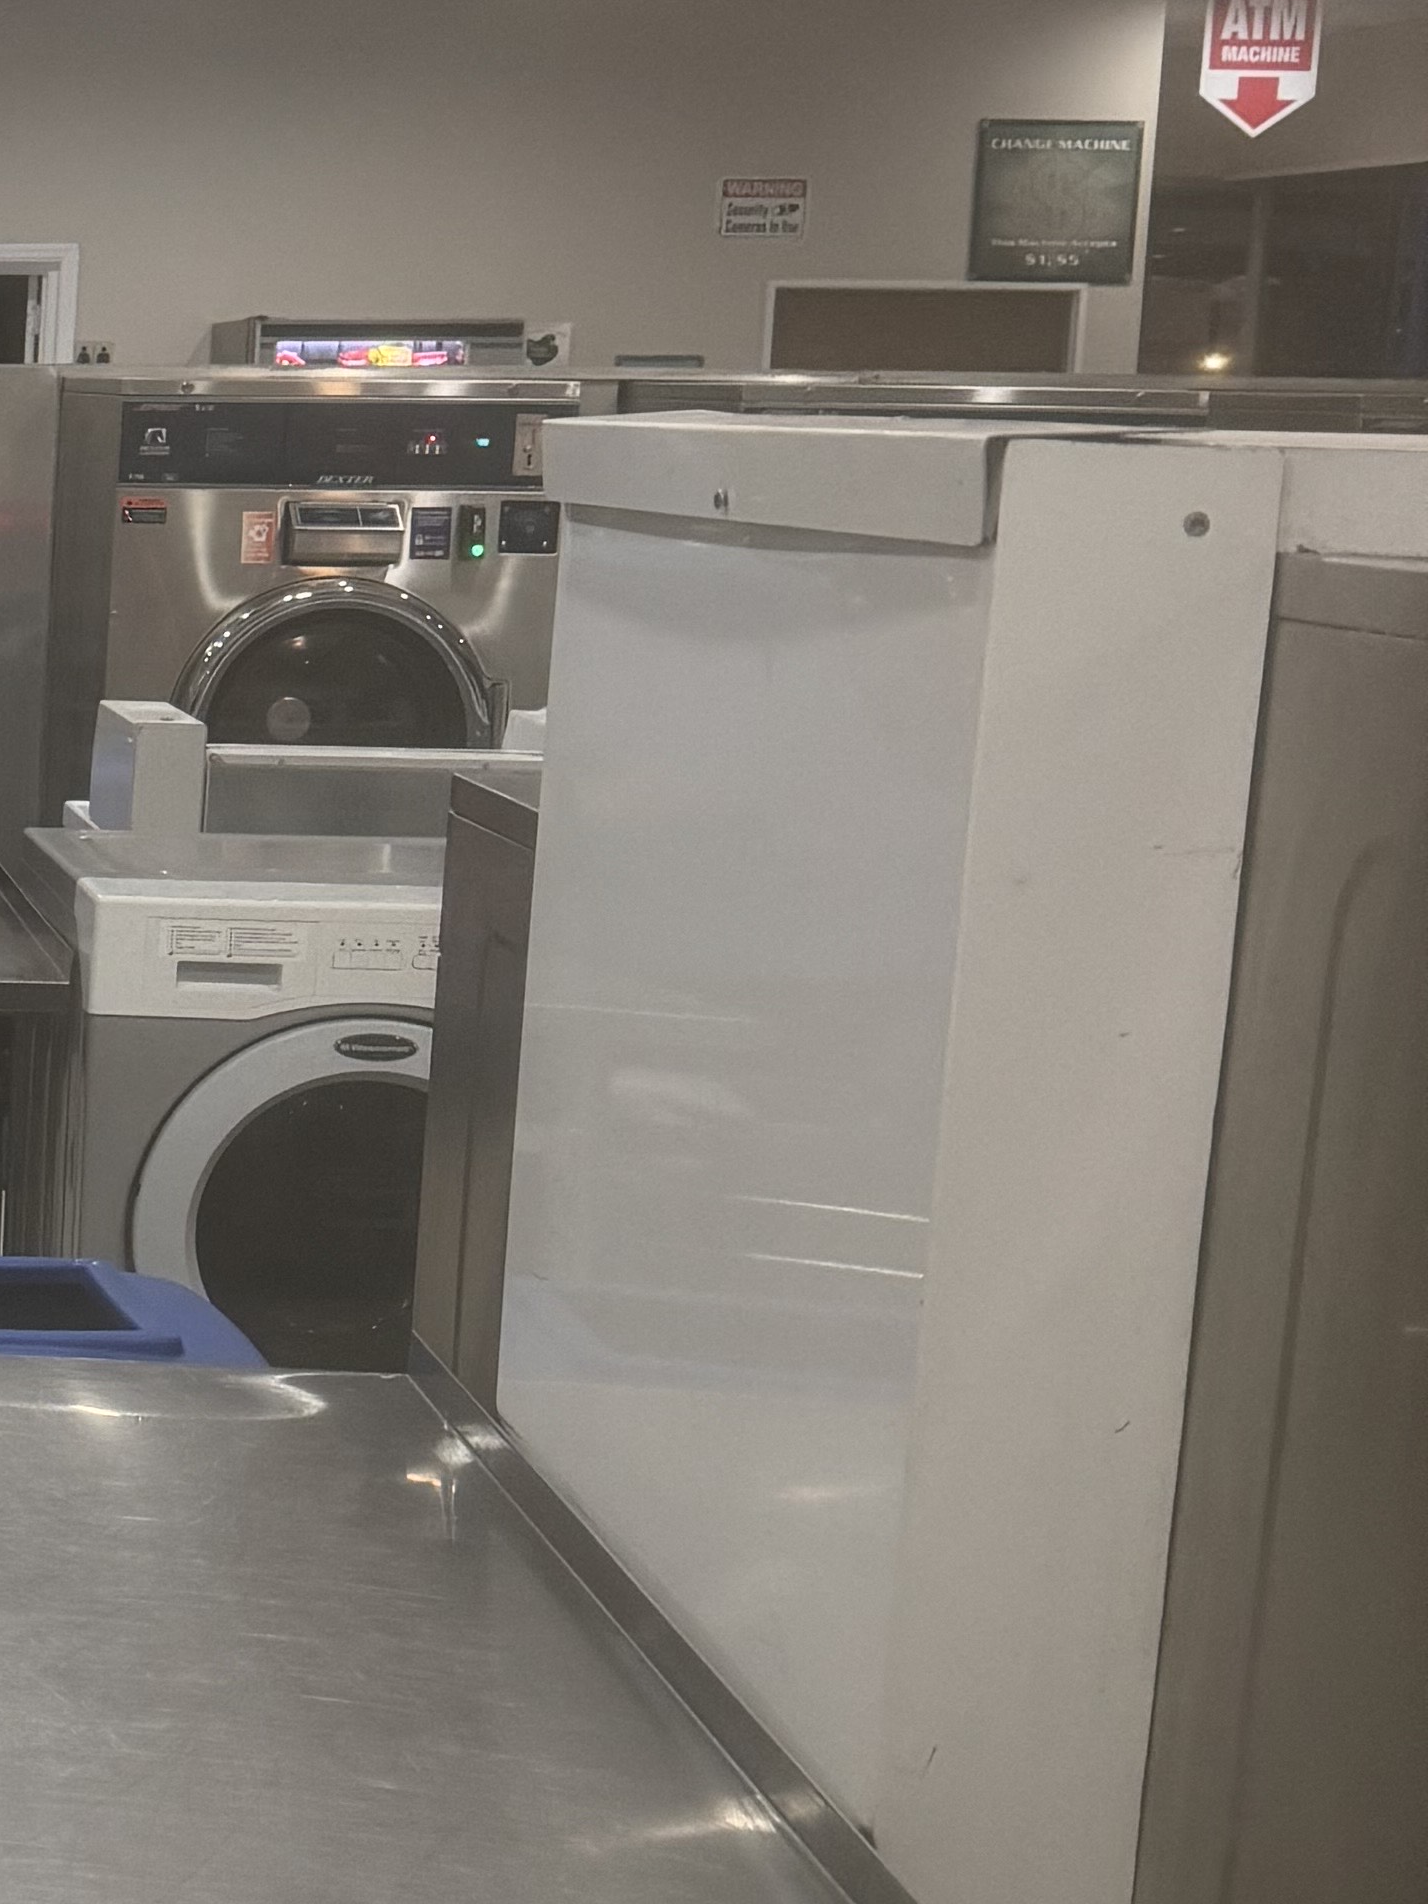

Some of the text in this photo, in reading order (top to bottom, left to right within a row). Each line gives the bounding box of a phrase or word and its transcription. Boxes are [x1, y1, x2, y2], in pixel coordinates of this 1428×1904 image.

[1220, 45, 1301, 64] MACHINE
[991, 137, 1132, 151] CHANGE MACHINE
